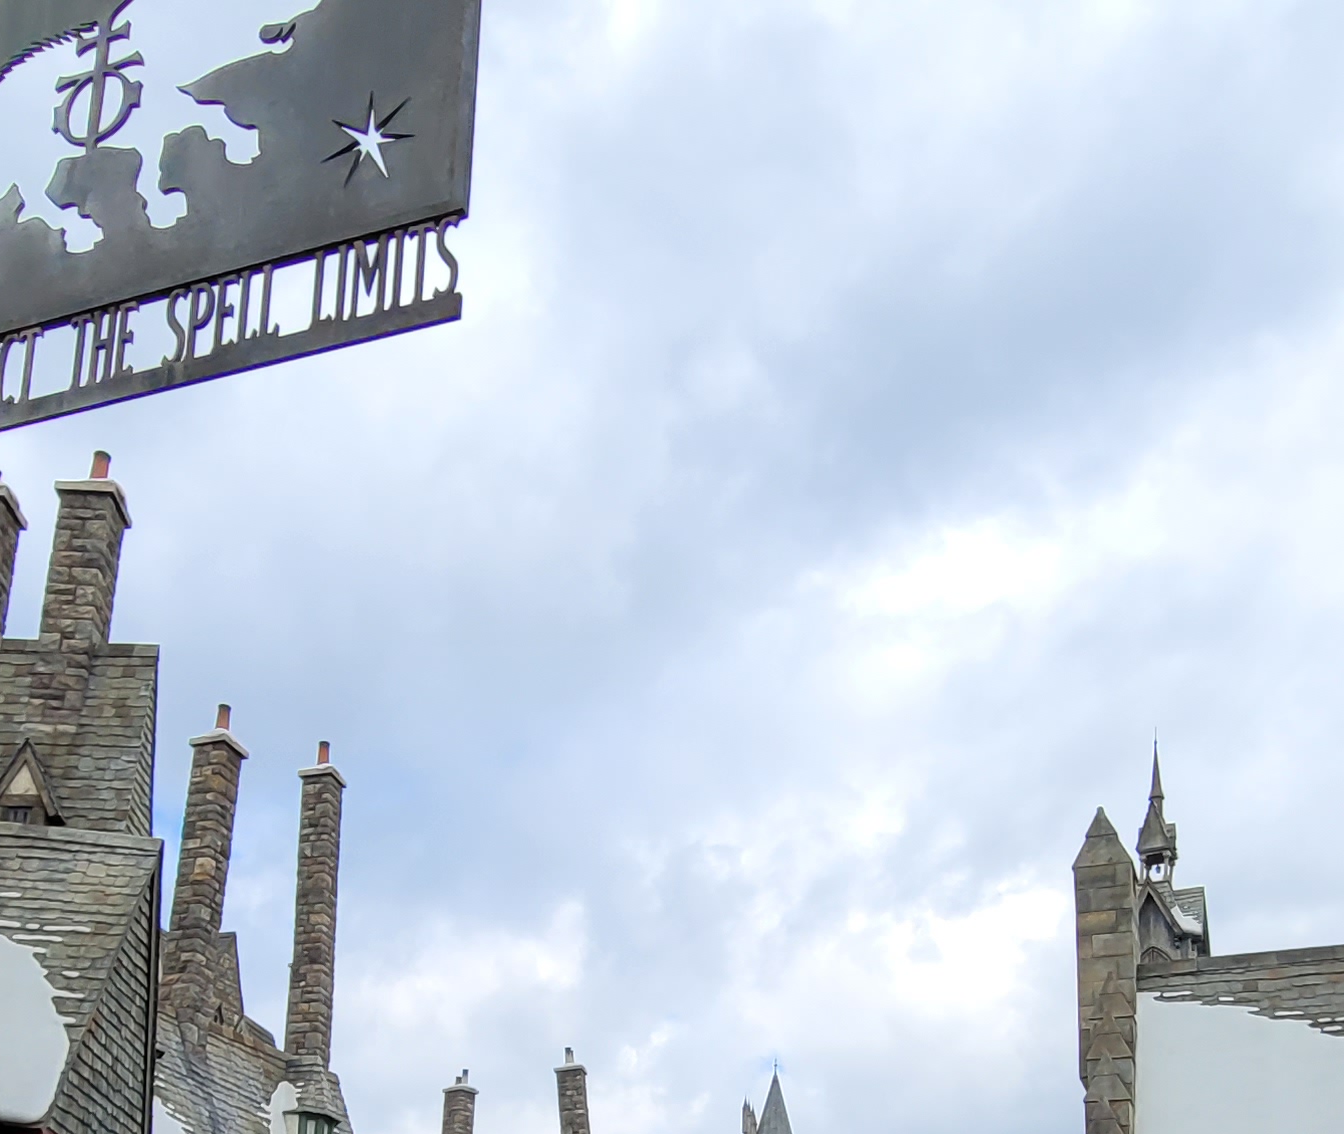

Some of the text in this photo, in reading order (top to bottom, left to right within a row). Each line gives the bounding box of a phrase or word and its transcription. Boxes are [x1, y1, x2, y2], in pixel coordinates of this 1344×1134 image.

[69, 301, 140, 390] THE
[161, 263, 280, 364] SPELL
[310, 215, 462, 325] LIMITS
